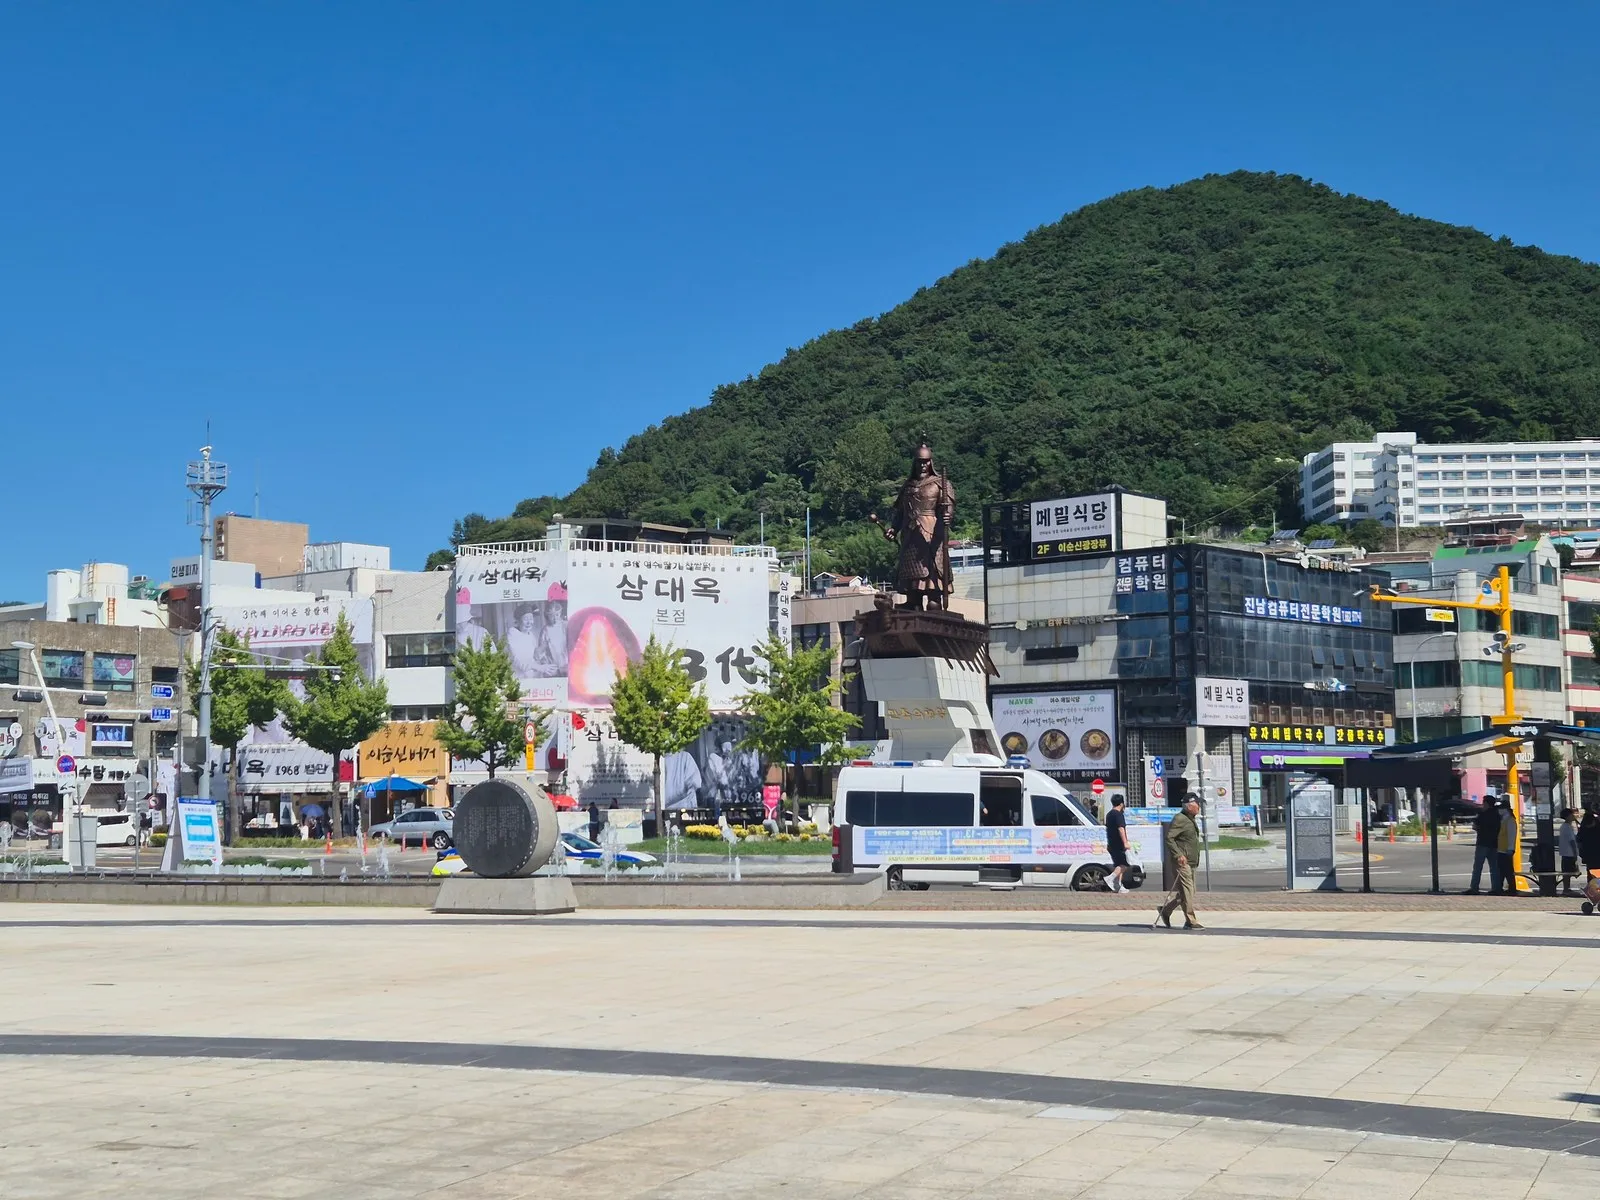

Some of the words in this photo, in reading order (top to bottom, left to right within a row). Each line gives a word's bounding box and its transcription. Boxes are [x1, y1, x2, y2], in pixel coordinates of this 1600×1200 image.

[1036, 501, 1107, 527] 메밀식당
[1037, 544, 1050, 555] 2F
[1058, 539, 1107, 553] 이순신광장뷰
[171, 563, 199, 578] 인생피자
[1118, 553, 1166, 574] 컴퓨터
[482, 566, 542, 585] 삼대옥
[1116, 573, 1166, 593] 전문학원
[615, 573, 721, 604] 삼대옥
[780, 580, 790, 618] 삼대옥
[272, 606, 298, 617] 이어온
[656, 608, 685, 623] 본점
[1244, 597, 1342, 623] 진남컴퓨터전문학원
[1008, 698, 1034, 706] NAVER
[1203, 686, 1244, 703] 메밀식당
[1249, 726, 1324, 742] 유자비빔막국수
[366, 744, 437, 765] 이순신버거
[275, 765, 300, 776] 1968
